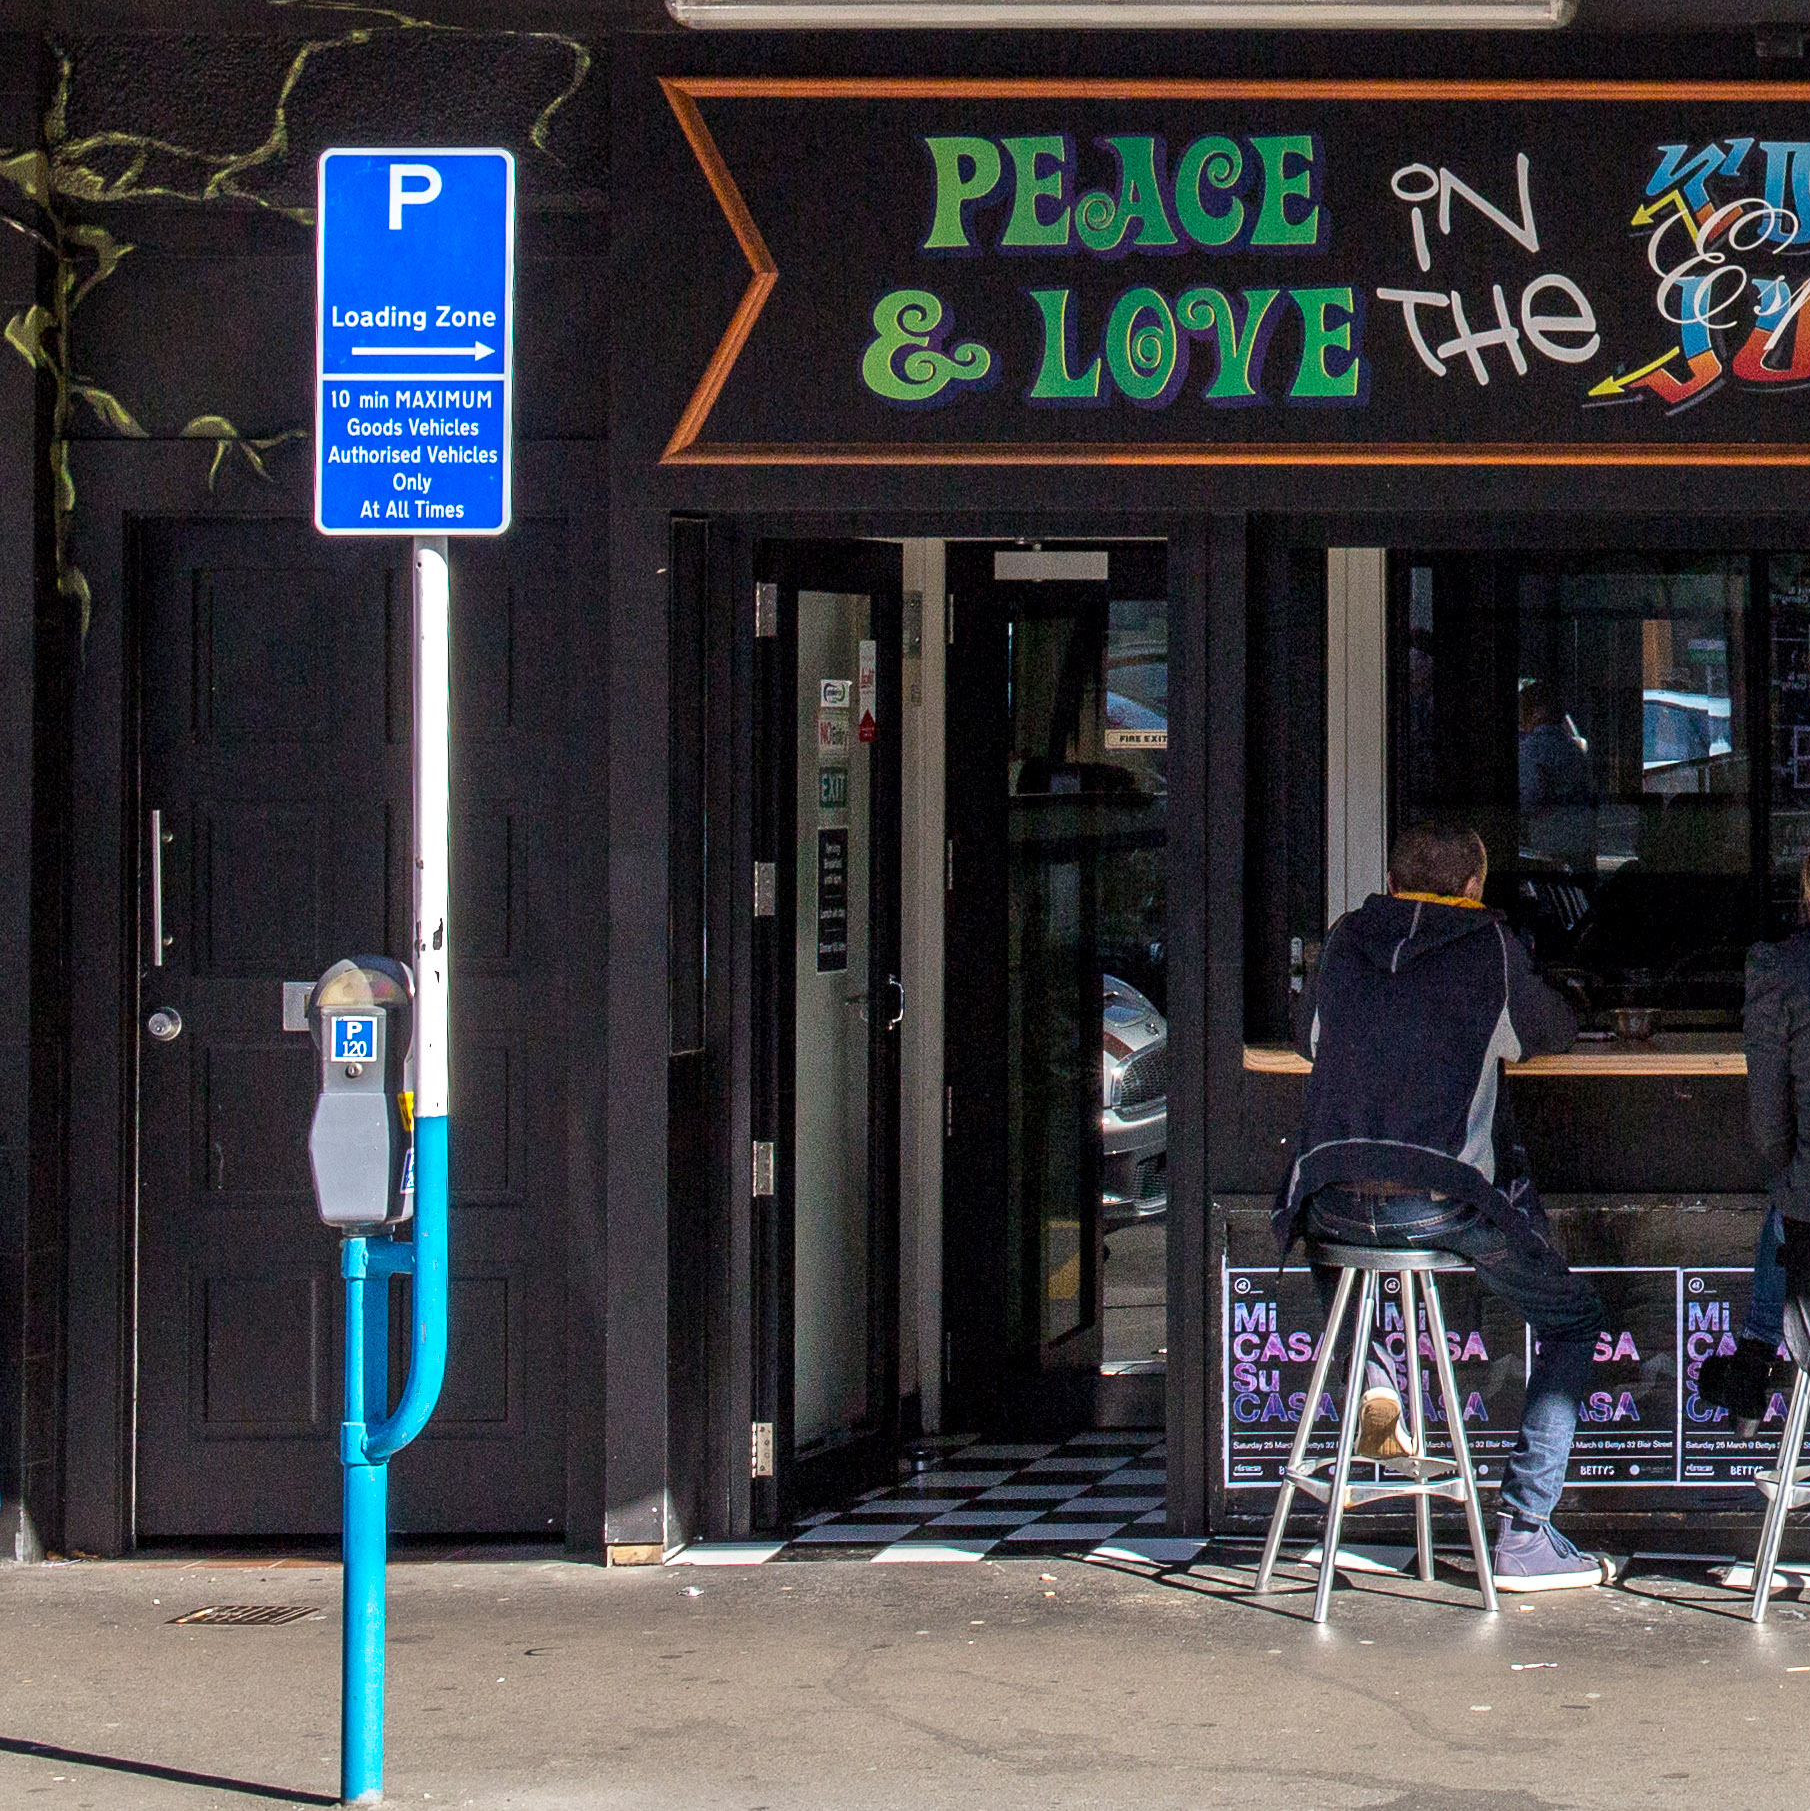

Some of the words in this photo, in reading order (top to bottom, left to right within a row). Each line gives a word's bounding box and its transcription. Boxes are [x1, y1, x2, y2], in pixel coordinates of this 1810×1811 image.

[389, 163, 442, 230] P
[923, 135, 1319, 251] PEACE
[332, 306, 426, 331] Loading
[435, 306, 496, 328] Zone
[862, 288, 991, 401] &
[1030, 287, 1359, 399] LOVE
[331, 390, 351, 408] 10
[359, 391, 389, 408] min
[396, 390, 492, 408] MAXIMUM
[347, 418, 402, 437] Goods
[408, 418, 479, 436] Vehicles
[328, 445, 421, 464] Authorised
[427, 445, 498, 463] Vehicles
[393, 473, 432, 493] Only
[360, 501, 380, 519] At
[385, 501, 410, 519] All
[414, 501, 464, 519] Times
[1119, 734, 1140, 743] FIRE
[821, 773, 846, 802] EXIT
[346, 1022, 362, 1039] P
[342, 1040, 367, 1057] 120
[1234, 1302, 1276, 1332] Mi
[1688, 1301, 1730, 1331] Mi
[1232, 1364, 1279, 1392] Su
[1233, 1441, 1262, 1451] Saturday
[1274, 1441, 1293, 1449] Marc
[1575, 1440, 1596, 1449] March
[1605, 1441, 1625, 1450] Bettys
[1626, 1440, 1636, 1448] 32
[1637, 1440, 1652, 1448] Blair
[1652, 1440, 1673, 1448] Street
[1685, 1441, 1714, 1450] Saturday
[1726, 1440, 1747, 1449] March
[1579, 1465, 1615, 1476] BETTYS
